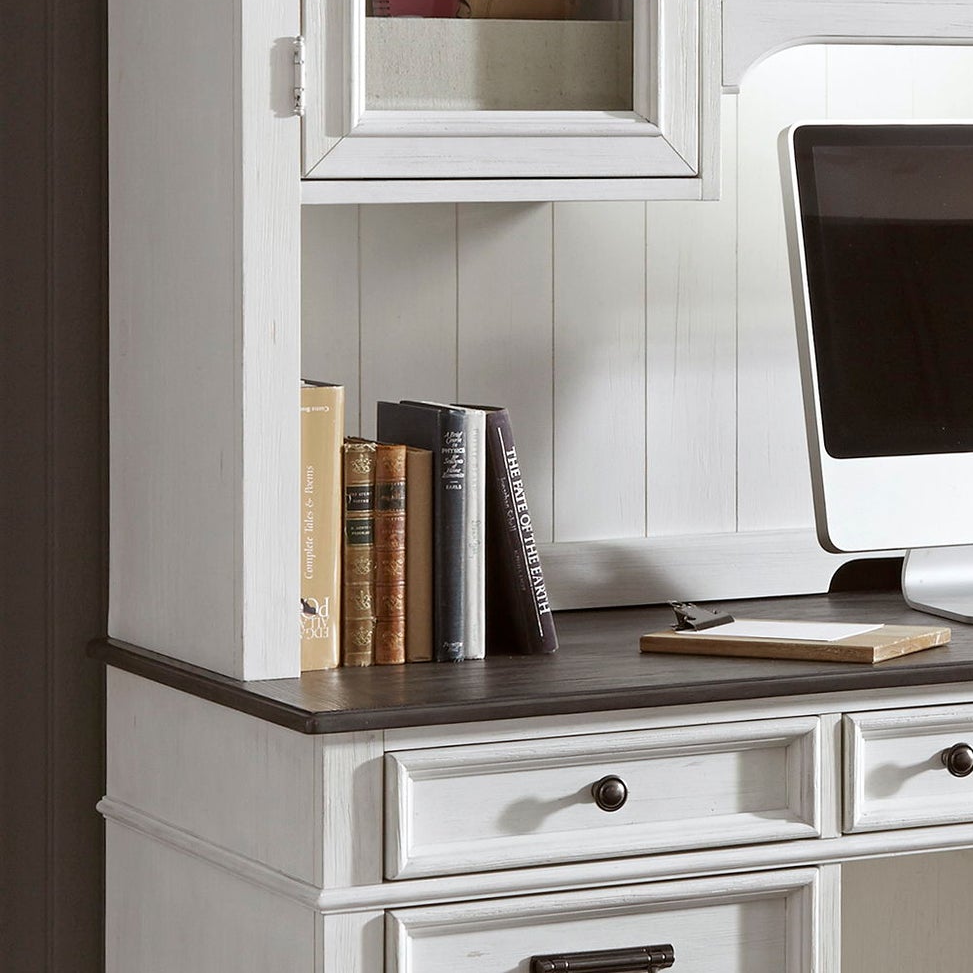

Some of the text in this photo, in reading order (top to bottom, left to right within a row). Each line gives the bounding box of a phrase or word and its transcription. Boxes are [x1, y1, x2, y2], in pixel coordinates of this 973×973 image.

[304, 465, 315, 580] Complete Tales & Poems
[505, 446, 550, 615] THE FATE OF THE EARTH
